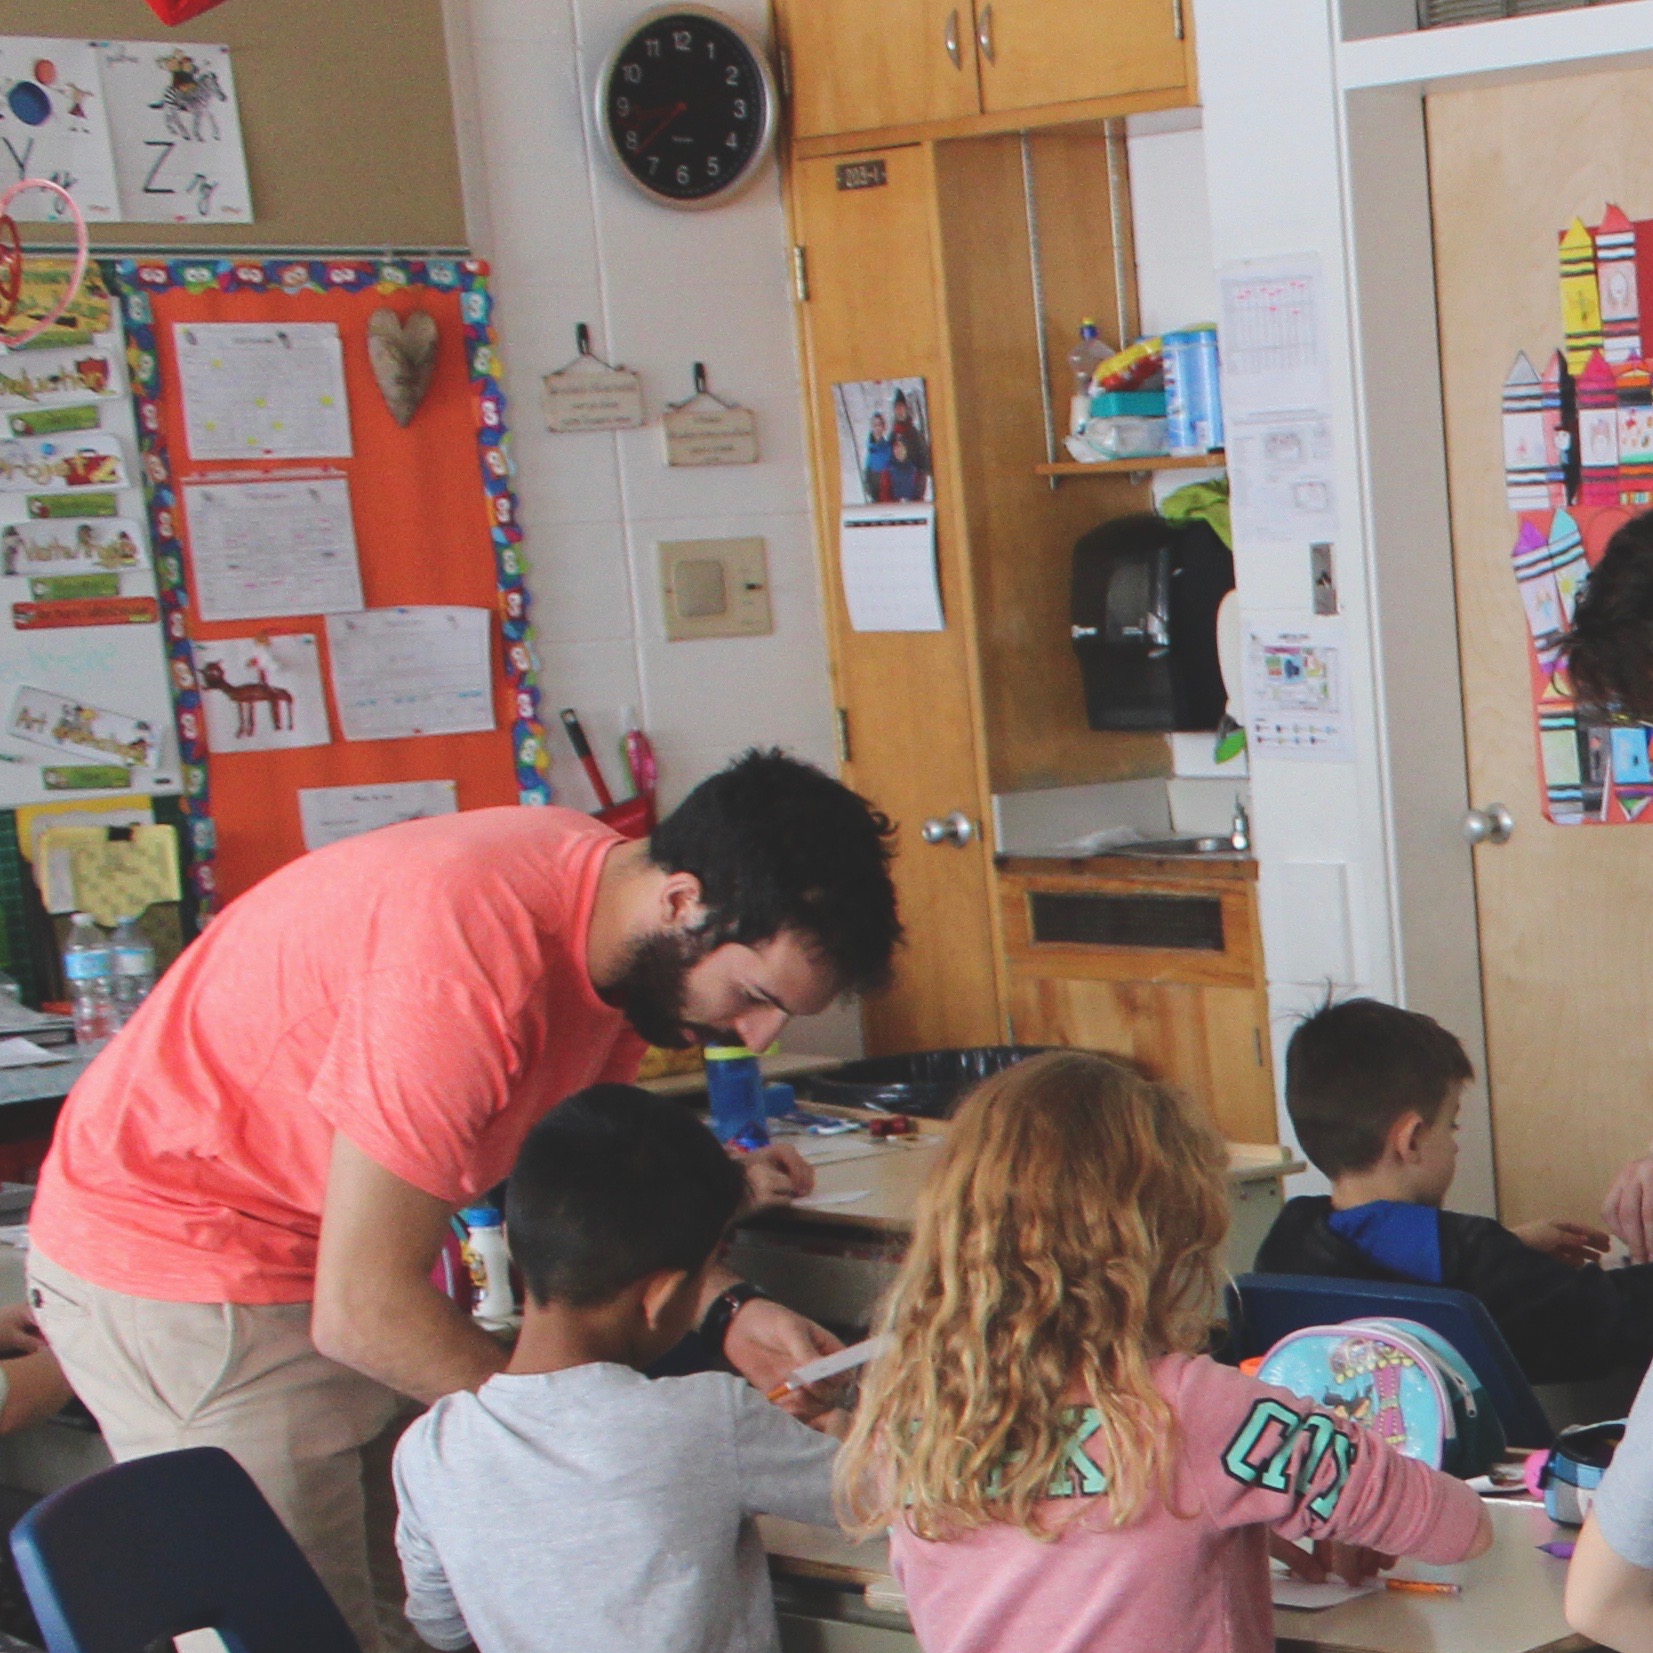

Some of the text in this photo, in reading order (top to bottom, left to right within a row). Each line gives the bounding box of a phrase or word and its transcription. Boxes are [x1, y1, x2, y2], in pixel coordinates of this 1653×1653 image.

[645, 38, 661, 57] 11
[672, 31, 692, 51] 12
[707, 42, 714, 59] 1
[622, 63, 642, 83] 10
[725, 66, 738, 85] 2
[617, 97, 629, 116] 9
[734, 99, 746, 119] 3
[625, 131, 637, 149] 8
[726, 131, 737, 149] 4
[143, 140, 175, 194] Z
[647, 156, 659, 175] 7
[677, 165, 690, 185] 6
[707, 156, 719, 176] 5
